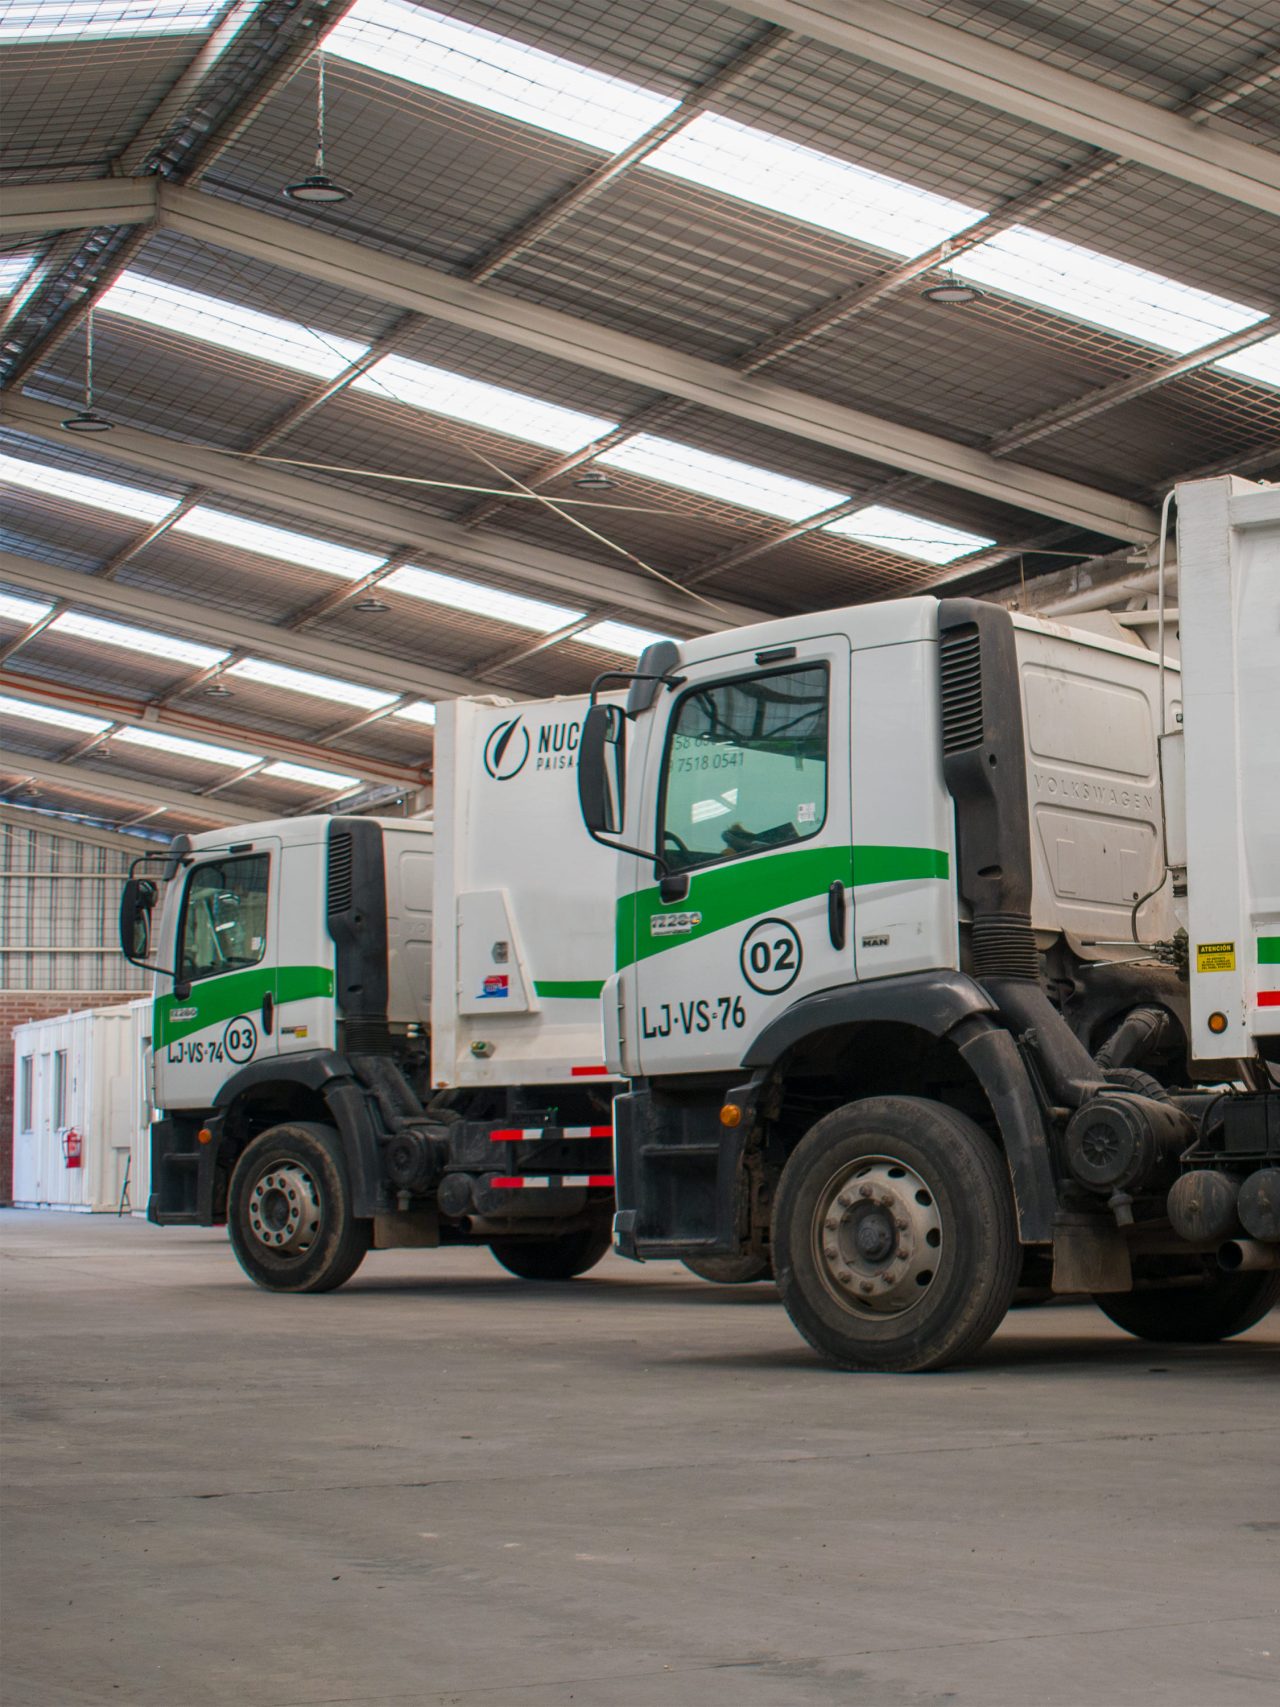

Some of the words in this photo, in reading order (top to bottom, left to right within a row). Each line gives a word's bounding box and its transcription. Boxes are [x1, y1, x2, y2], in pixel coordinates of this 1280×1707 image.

[538, 722, 579, 753] NUC
[536, 755, 578, 771] PAISA
[678, 756, 709, 773] 7518
[713, 752, 744, 769] 0541
[1034, 774, 1153, 812] VOLKSWAGEN
[862, 939, 888, 948] MAN
[751, 939, 795, 974] 02
[230, 1029, 253, 1050] 03
